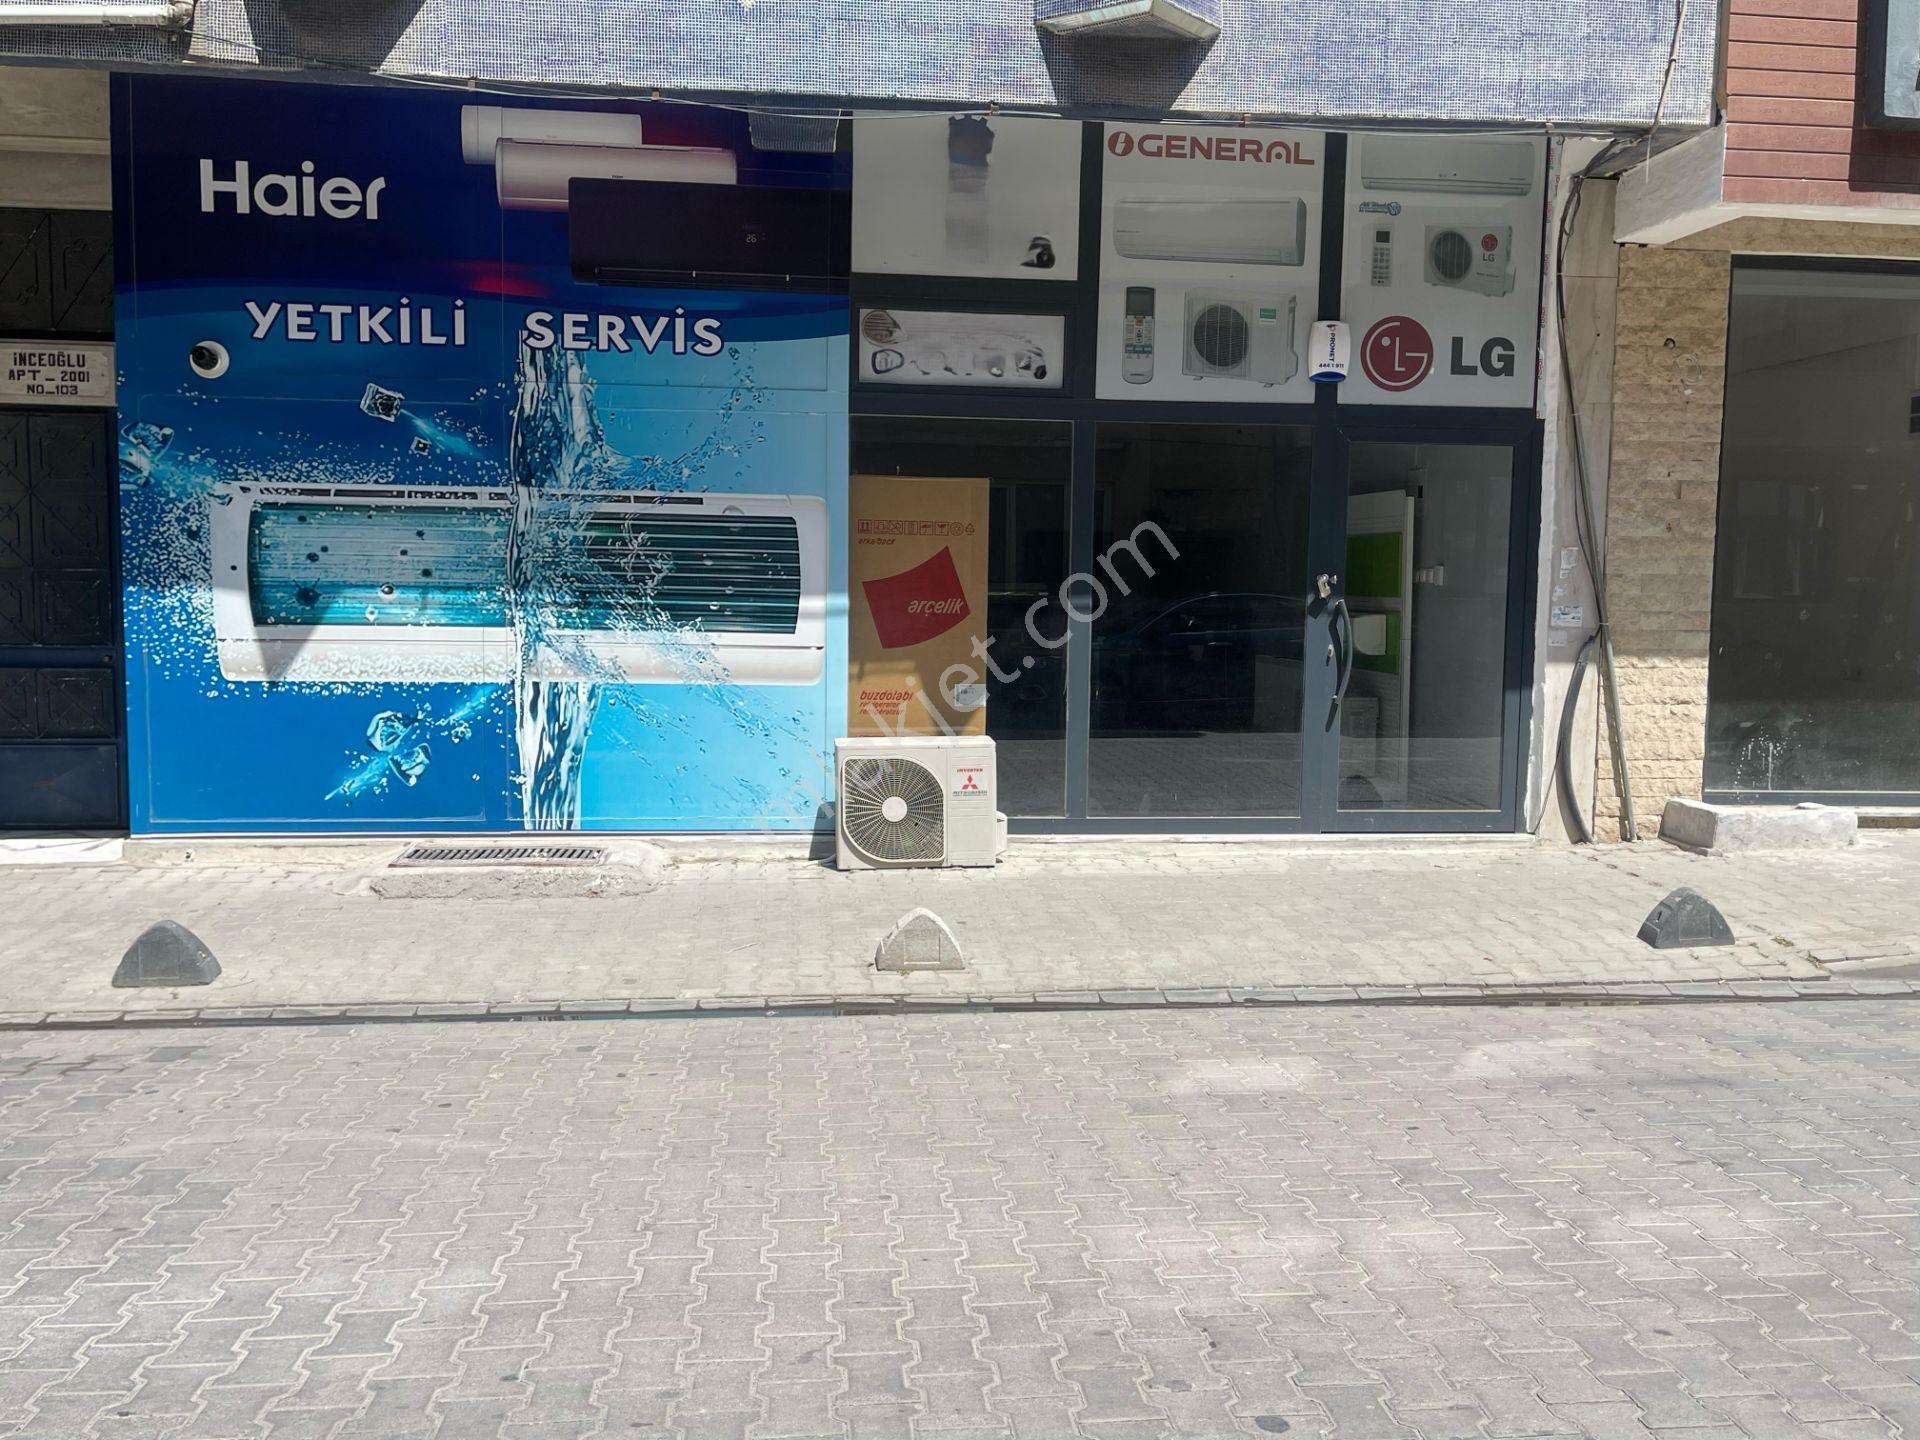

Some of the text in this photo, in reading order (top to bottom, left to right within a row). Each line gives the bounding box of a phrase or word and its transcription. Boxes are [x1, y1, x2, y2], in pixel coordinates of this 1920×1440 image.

[1137, 133, 1315, 165] GENERAL
[199, 158, 386, 220] Haier
[1482, 252, 1495, 262] LG
[244, 296, 723, 355] YETKİLİ SERVİS
[13, 351, 86, 368] İNCEOĞLU
[1450, 336, 1515, 377] LG
[8, 369, 41, 381] APT
[60, 371, 90, 382] 2001
[908, 598, 965, 616] arçelik
